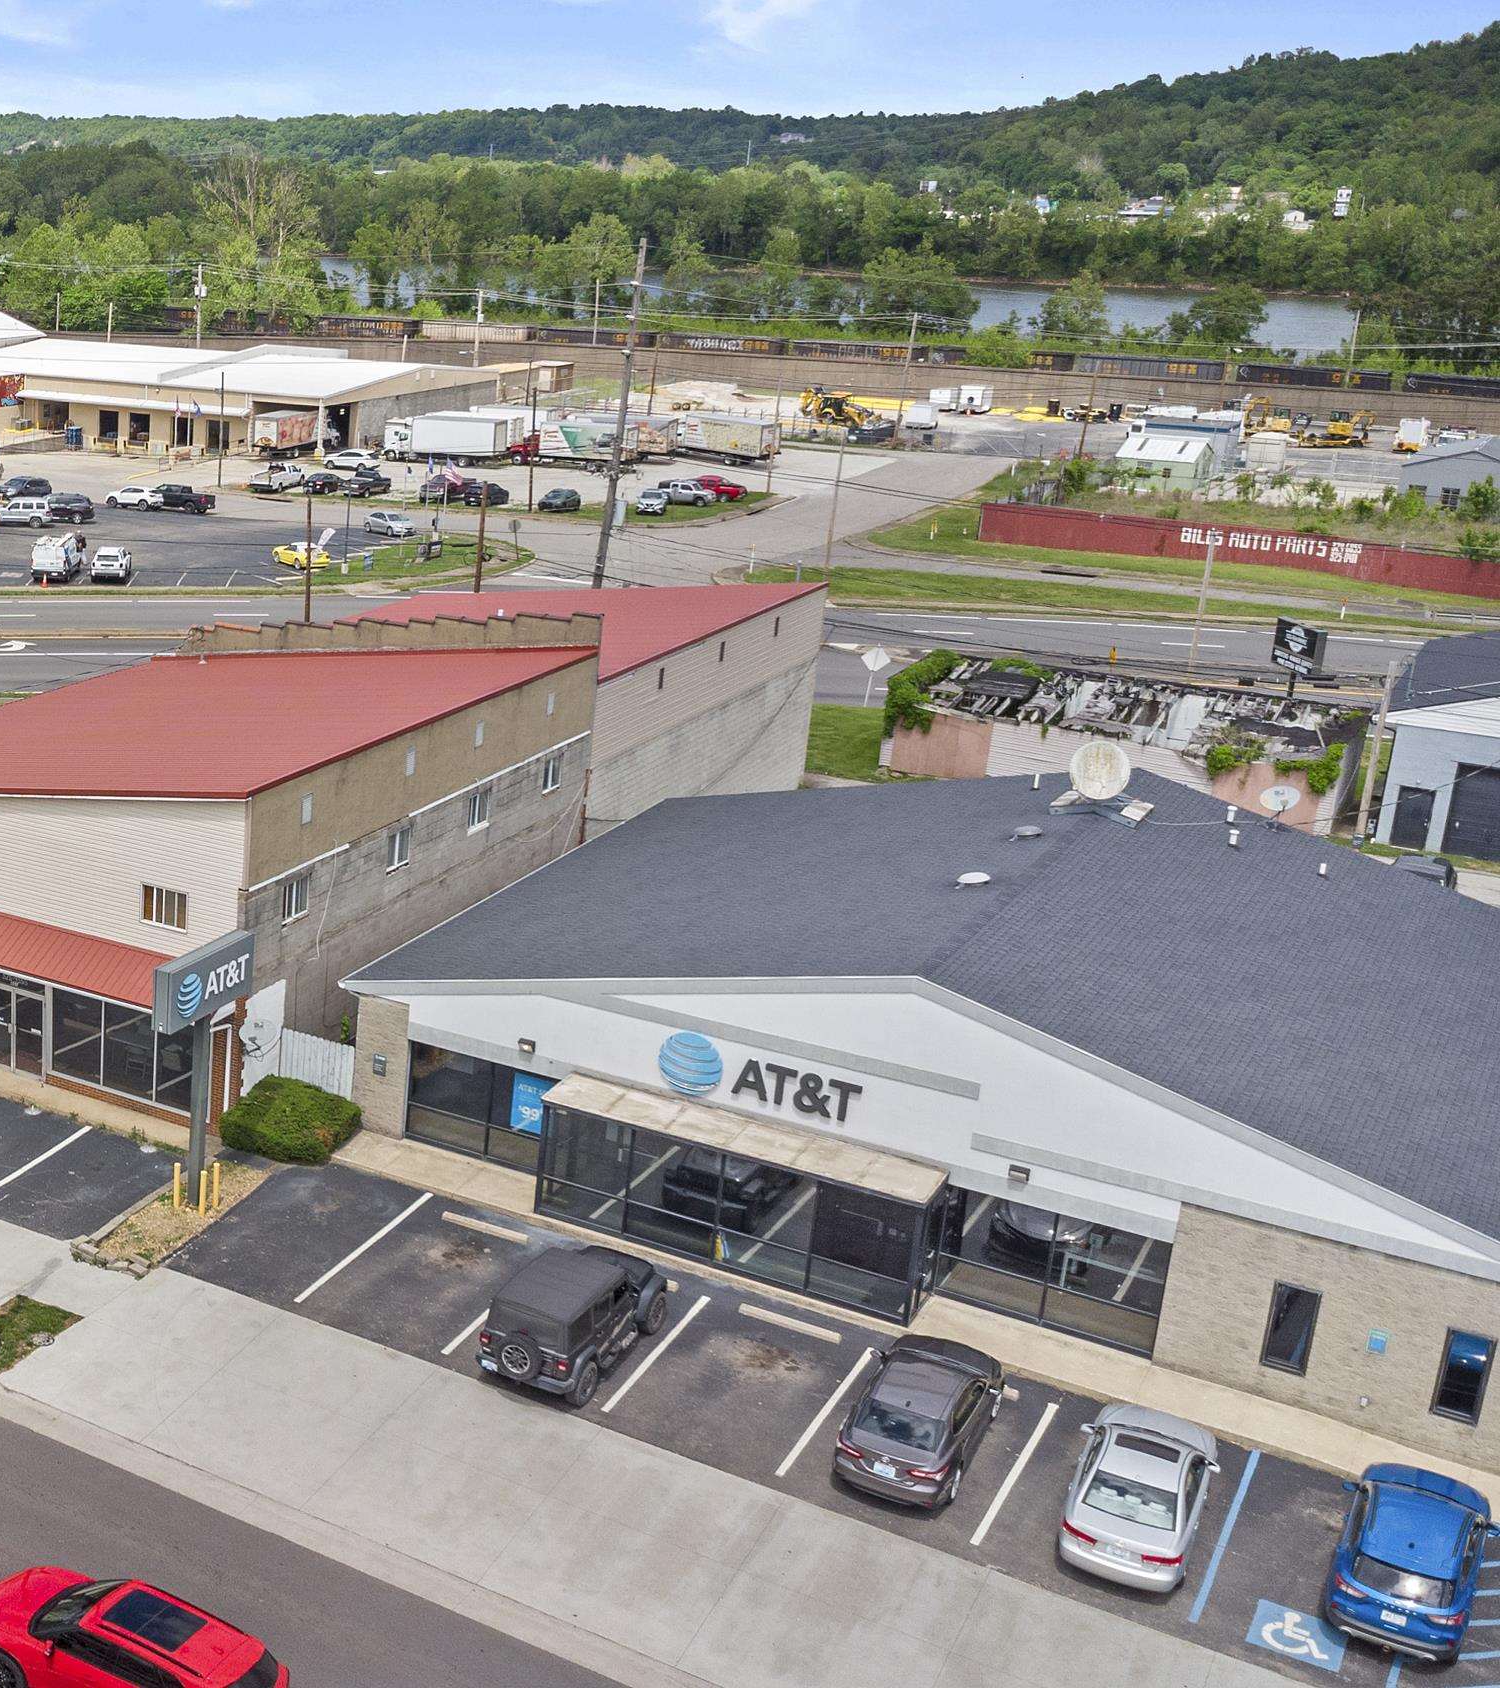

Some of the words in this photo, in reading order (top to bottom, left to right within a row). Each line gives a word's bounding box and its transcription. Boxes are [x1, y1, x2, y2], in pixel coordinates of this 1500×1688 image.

[1332, 372, 1361, 384] CX
[1228, 532, 1271, 551] AUTO
[1275, 535, 1328, 557] PARTS
[204, 953, 250, 1000] AT&T
[731, 1058, 864, 1122] AT&T
